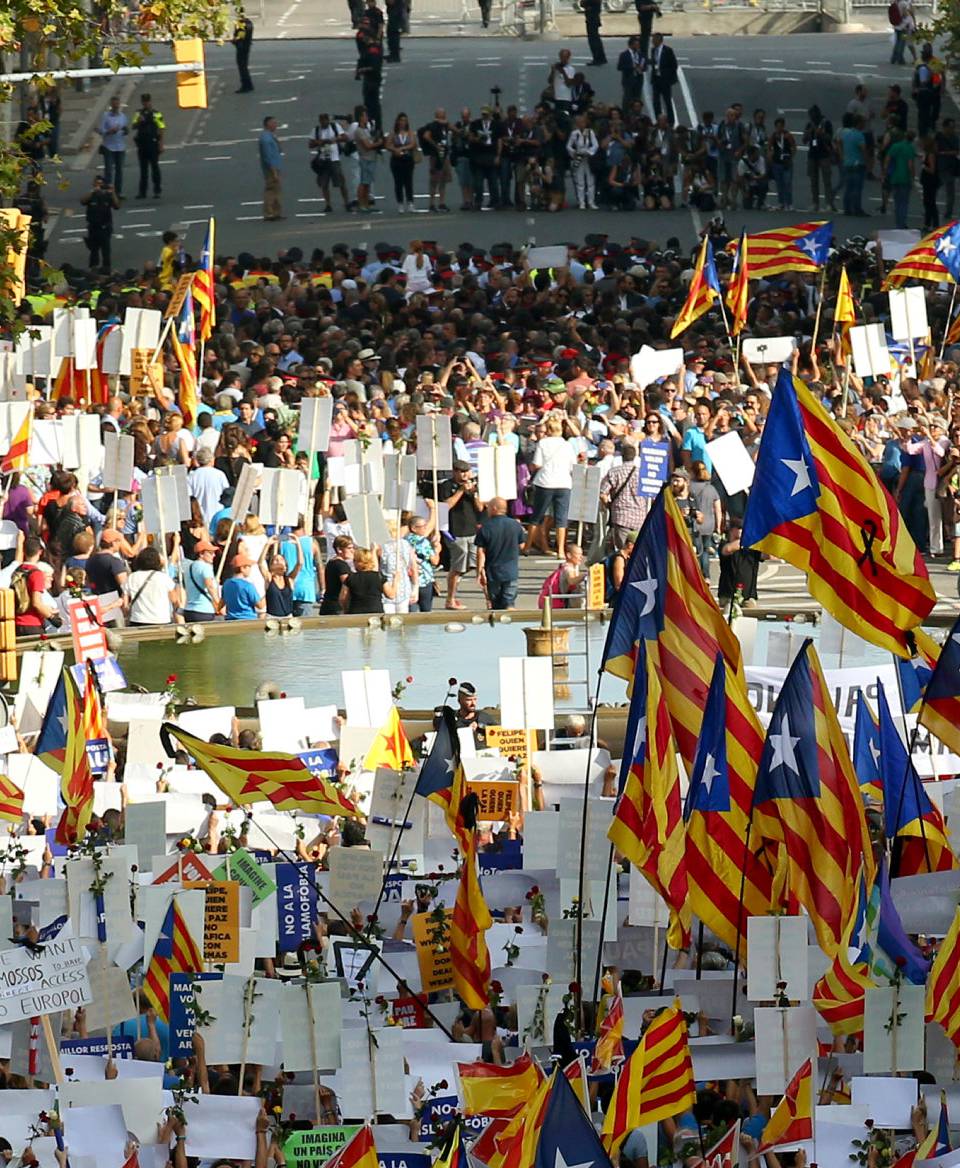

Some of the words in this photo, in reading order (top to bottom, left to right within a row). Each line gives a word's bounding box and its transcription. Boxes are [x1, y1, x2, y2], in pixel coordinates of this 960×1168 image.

[205, 886, 228, 895] LIPE,
[283, 884, 294, 900] LA
[284, 902, 295, 912] A
[297, 863, 310, 941] LAMOFÒBIA
[284, 921, 296, 936] NO
[205, 933, 231, 941] AFICA
[41, 969, 86, 989] ACCESS
[20, 987, 91, 1015] EUROPOL
[431, 1104, 451, 1115] NO
[302, 1131, 346, 1143] IMAGINA
[293, 1144, 307, 1156] UN
[309, 1140, 333, 1155] PAÍS
